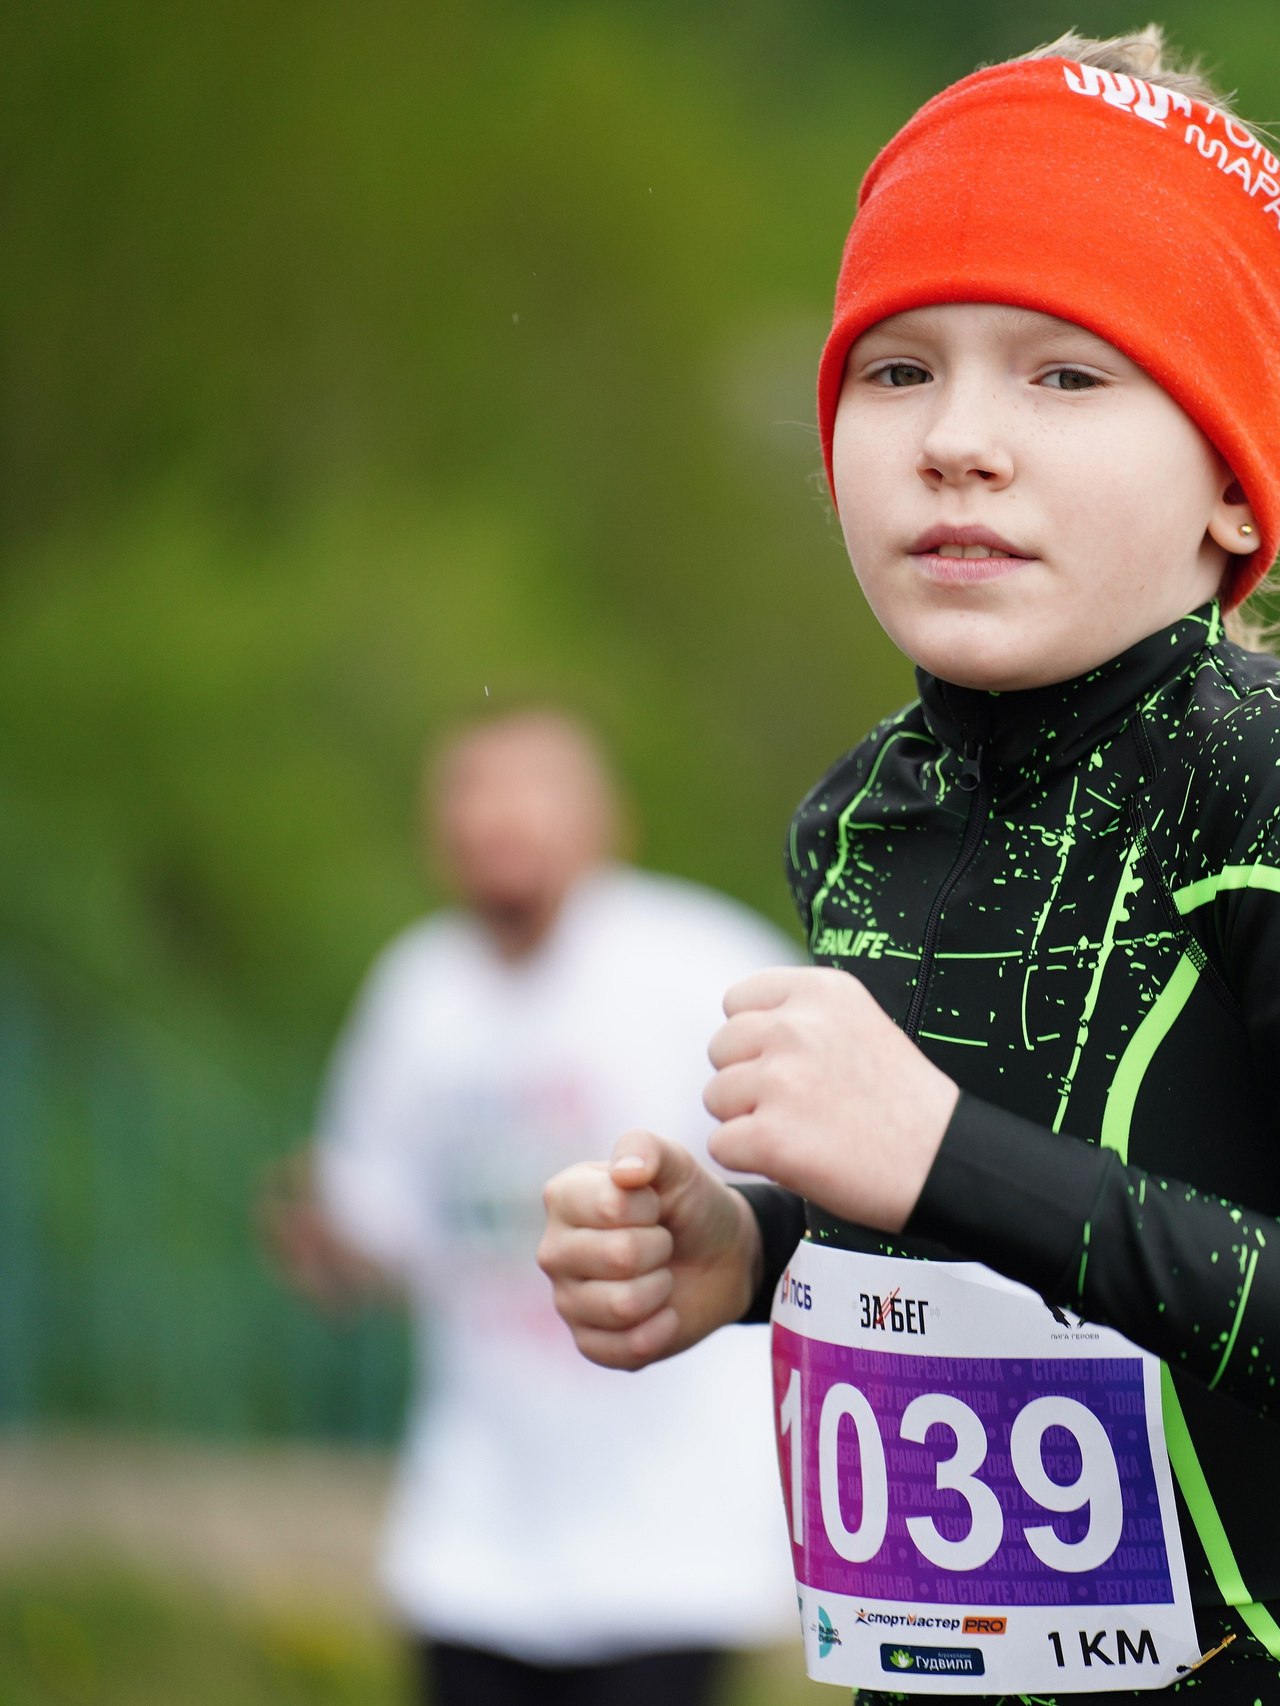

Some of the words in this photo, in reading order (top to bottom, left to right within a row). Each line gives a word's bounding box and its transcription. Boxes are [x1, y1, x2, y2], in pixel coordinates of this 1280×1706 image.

[790, 1278, 812, 1310] ПСБ
[780, 1367, 1123, 1573] 1039
[964, 1618, 1004, 1633] PRO
[1047, 1631, 1066, 1667] 1
